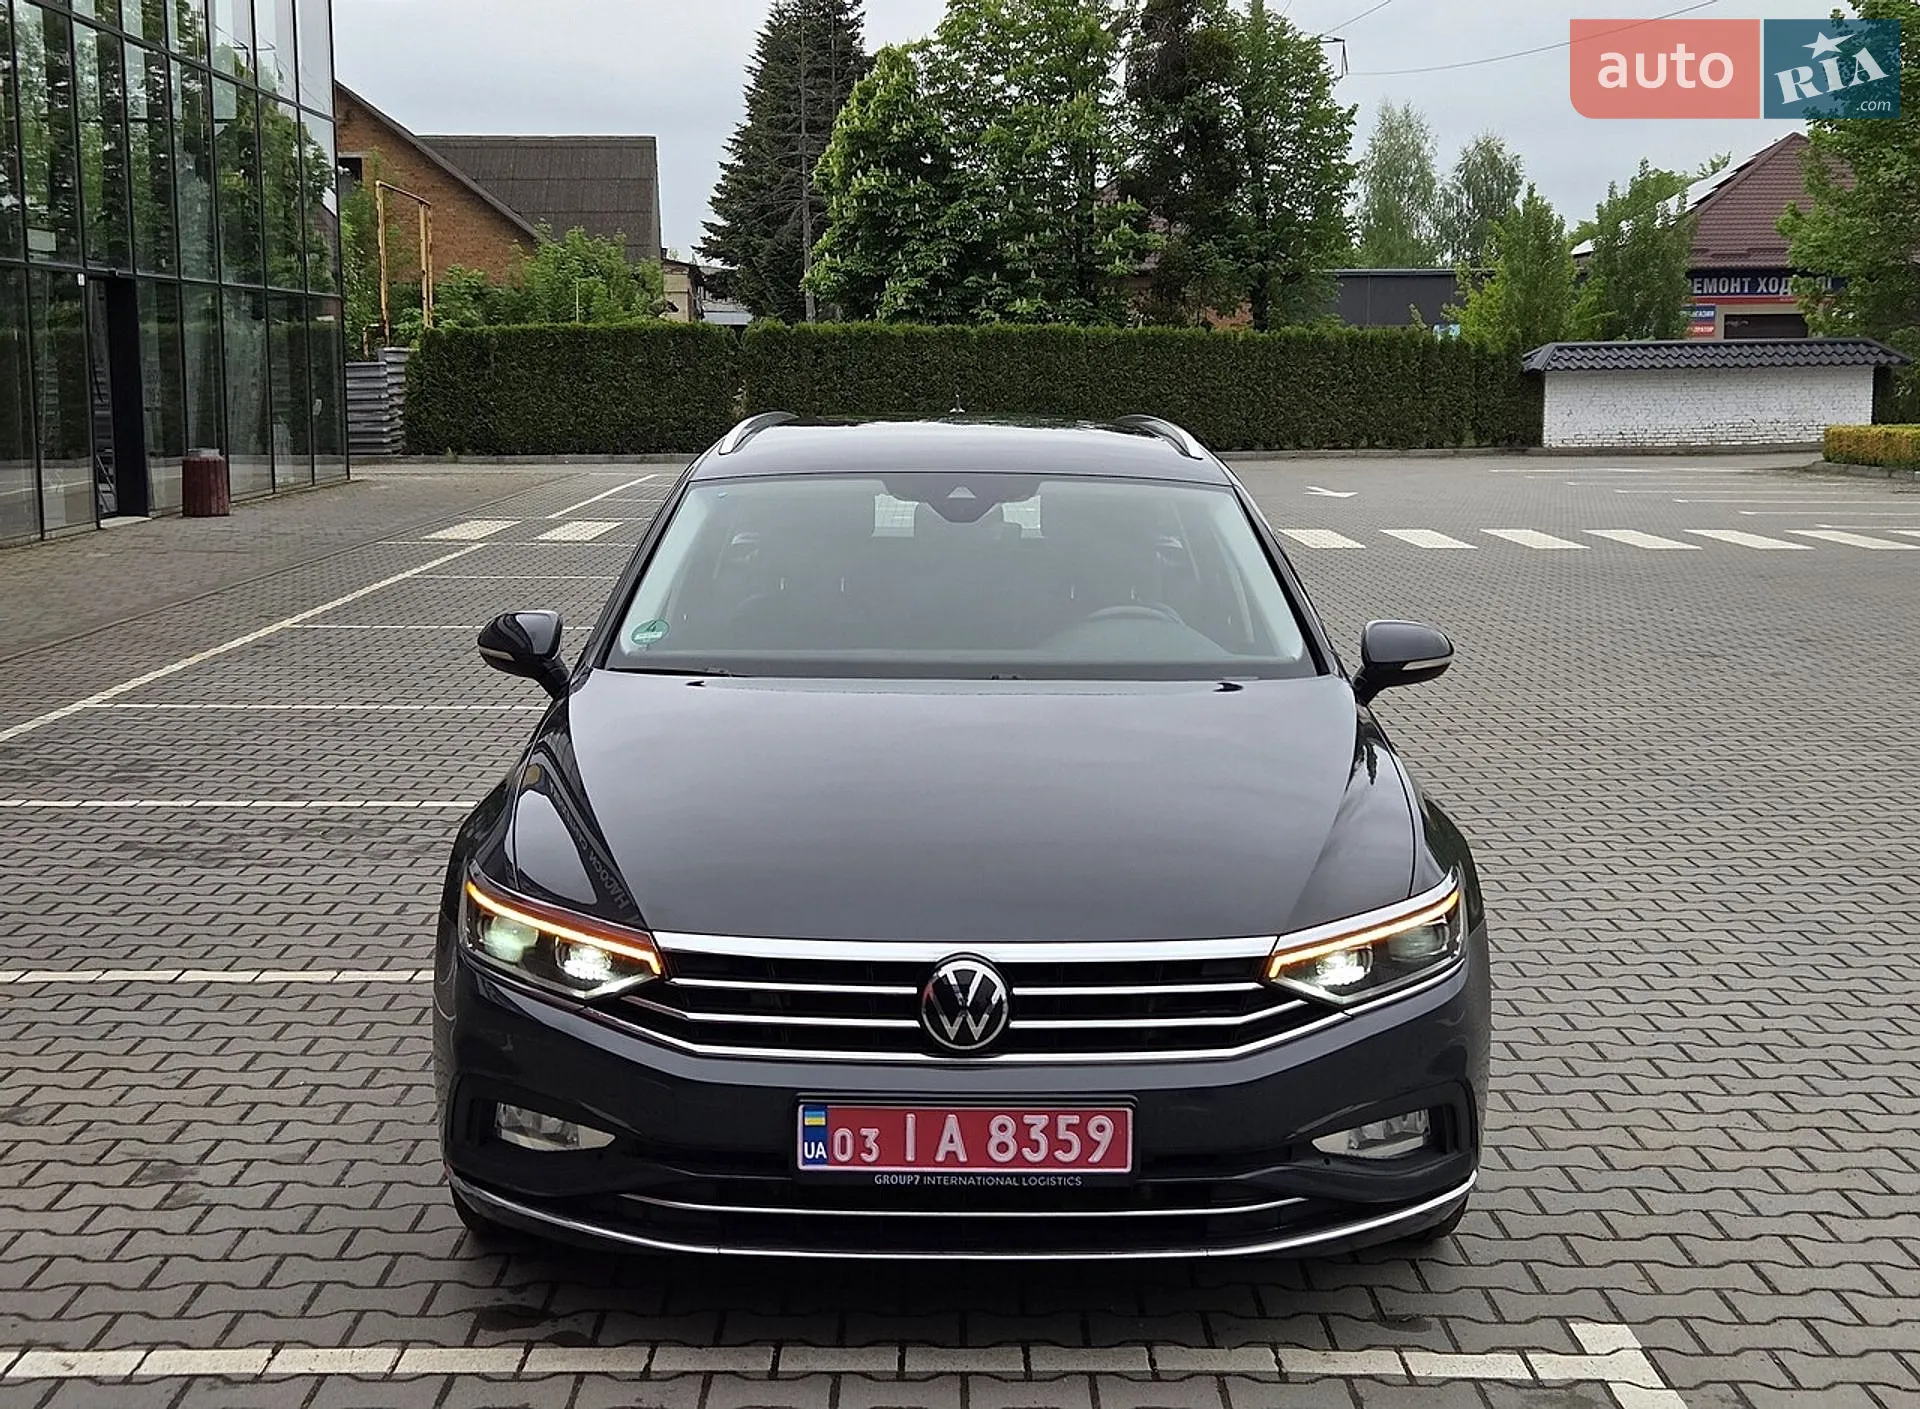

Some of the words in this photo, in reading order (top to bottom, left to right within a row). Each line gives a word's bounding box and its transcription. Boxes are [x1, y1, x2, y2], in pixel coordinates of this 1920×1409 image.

[833, 1128, 880, 1162] 03
[987, 1114, 1114, 1163] 8359
[804, 1142, 827, 1159] UA
[874, 1174, 920, 1185] GROUP7
[923, 1176, 1019, 1186] INTERNATIONAL
[1022, 1176, 1082, 1186] LOGISTICS
